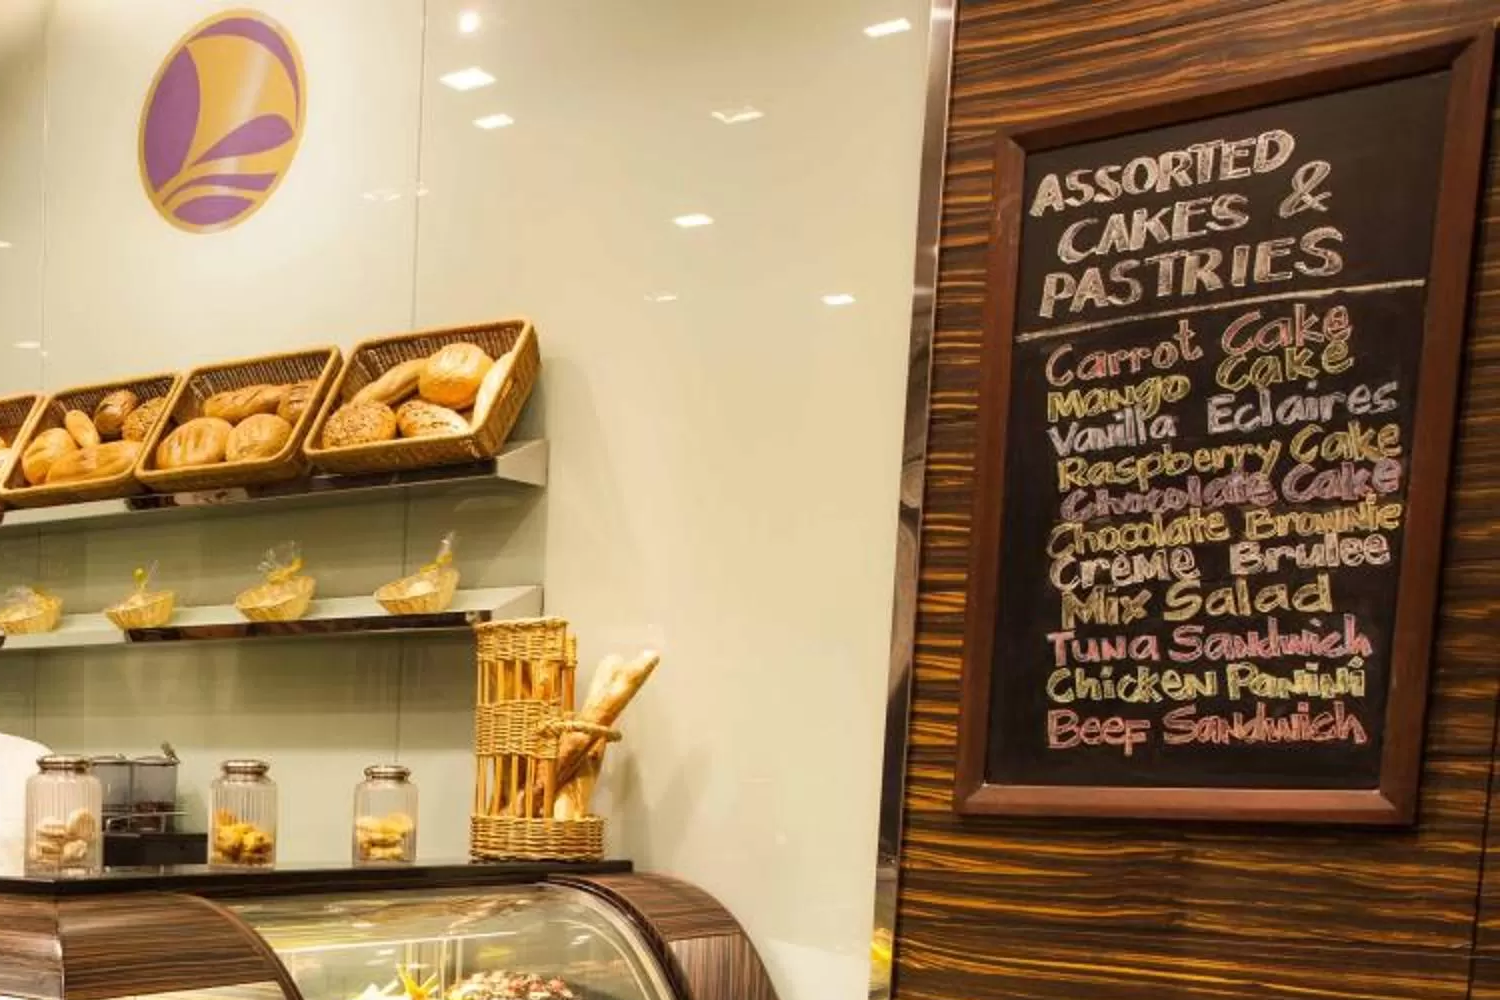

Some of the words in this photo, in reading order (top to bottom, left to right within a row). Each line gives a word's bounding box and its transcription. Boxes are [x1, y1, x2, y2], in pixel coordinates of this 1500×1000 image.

[1029, 128, 1296, 217] ASSORTED
[1057, 192, 1251, 265] CAKES
[1279, 160, 1333, 219] &
[1038, 226, 1344, 319] PASTRIES
[1044, 319, 1204, 387] Carrot
[1221, 303, 1353, 356] Cake
[1047, 373, 1192, 424] Mango
[1215, 340, 1355, 393] Cake
[1046, 408, 1178, 457] Vanilla
[1207, 380, 1399, 435] Eclaires
[1057, 440, 1283, 494] Raspberry
[1290, 420, 1403, 463] Cake
[1060, 468, 1278, 522] Chocolate
[1281, 459, 1402, 503] Cake
[1047, 506, 1231, 560] Chocolate
[1244, 493, 1402, 541] Brownie
[1230, 532, 1391, 575] Brulee
[1061, 584, 1153, 631] Mix
[1163, 572, 1334, 622] Salad
[1046, 630, 1161, 668] Tuna
[1168, 613, 1373, 662] Sandwich
[1046, 665, 1219, 703] Chicken
[1226, 656, 1366, 701] Panini
[1047, 708, 1151, 758] Beef
[1162, 701, 1369, 745] Sandwich
